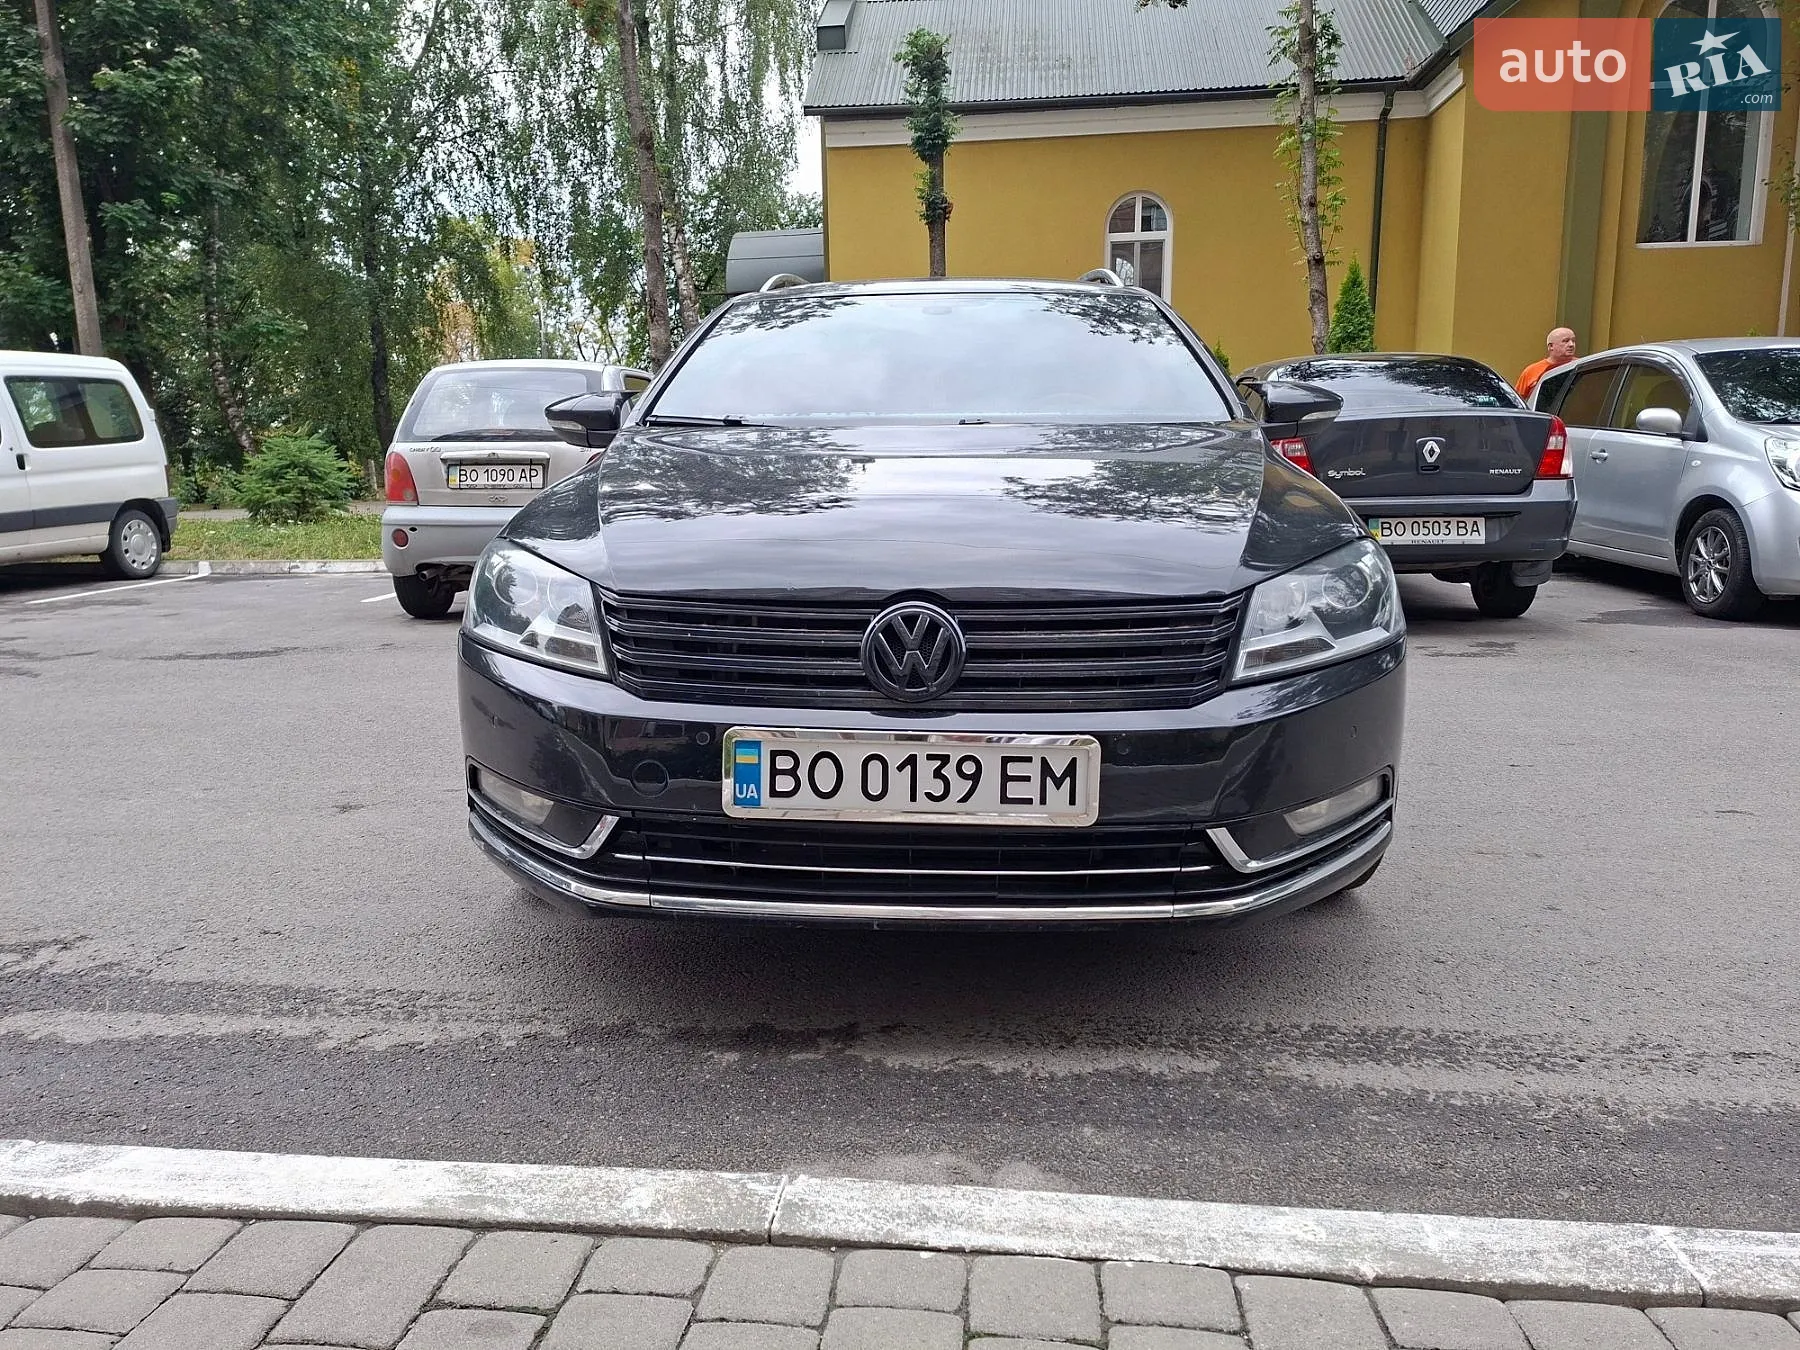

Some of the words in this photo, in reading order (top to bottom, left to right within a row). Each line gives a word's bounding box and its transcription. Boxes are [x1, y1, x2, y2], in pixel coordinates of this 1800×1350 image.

[459, 468, 479, 482] BO
[484, 468, 515, 482] 1090
[519, 468, 539, 482] AP
[1327, 467, 1366, 479] Symbol
[1380, 521, 1406, 537] BO
[1411, 520, 1451, 536] 0503
[1456, 520, 1481, 537] BA
[768, 749, 844, 800] BO
[860, 752, 983, 803] 0139
[1000, 755, 1078, 806] EM
[735, 783, 759, 799] UA
